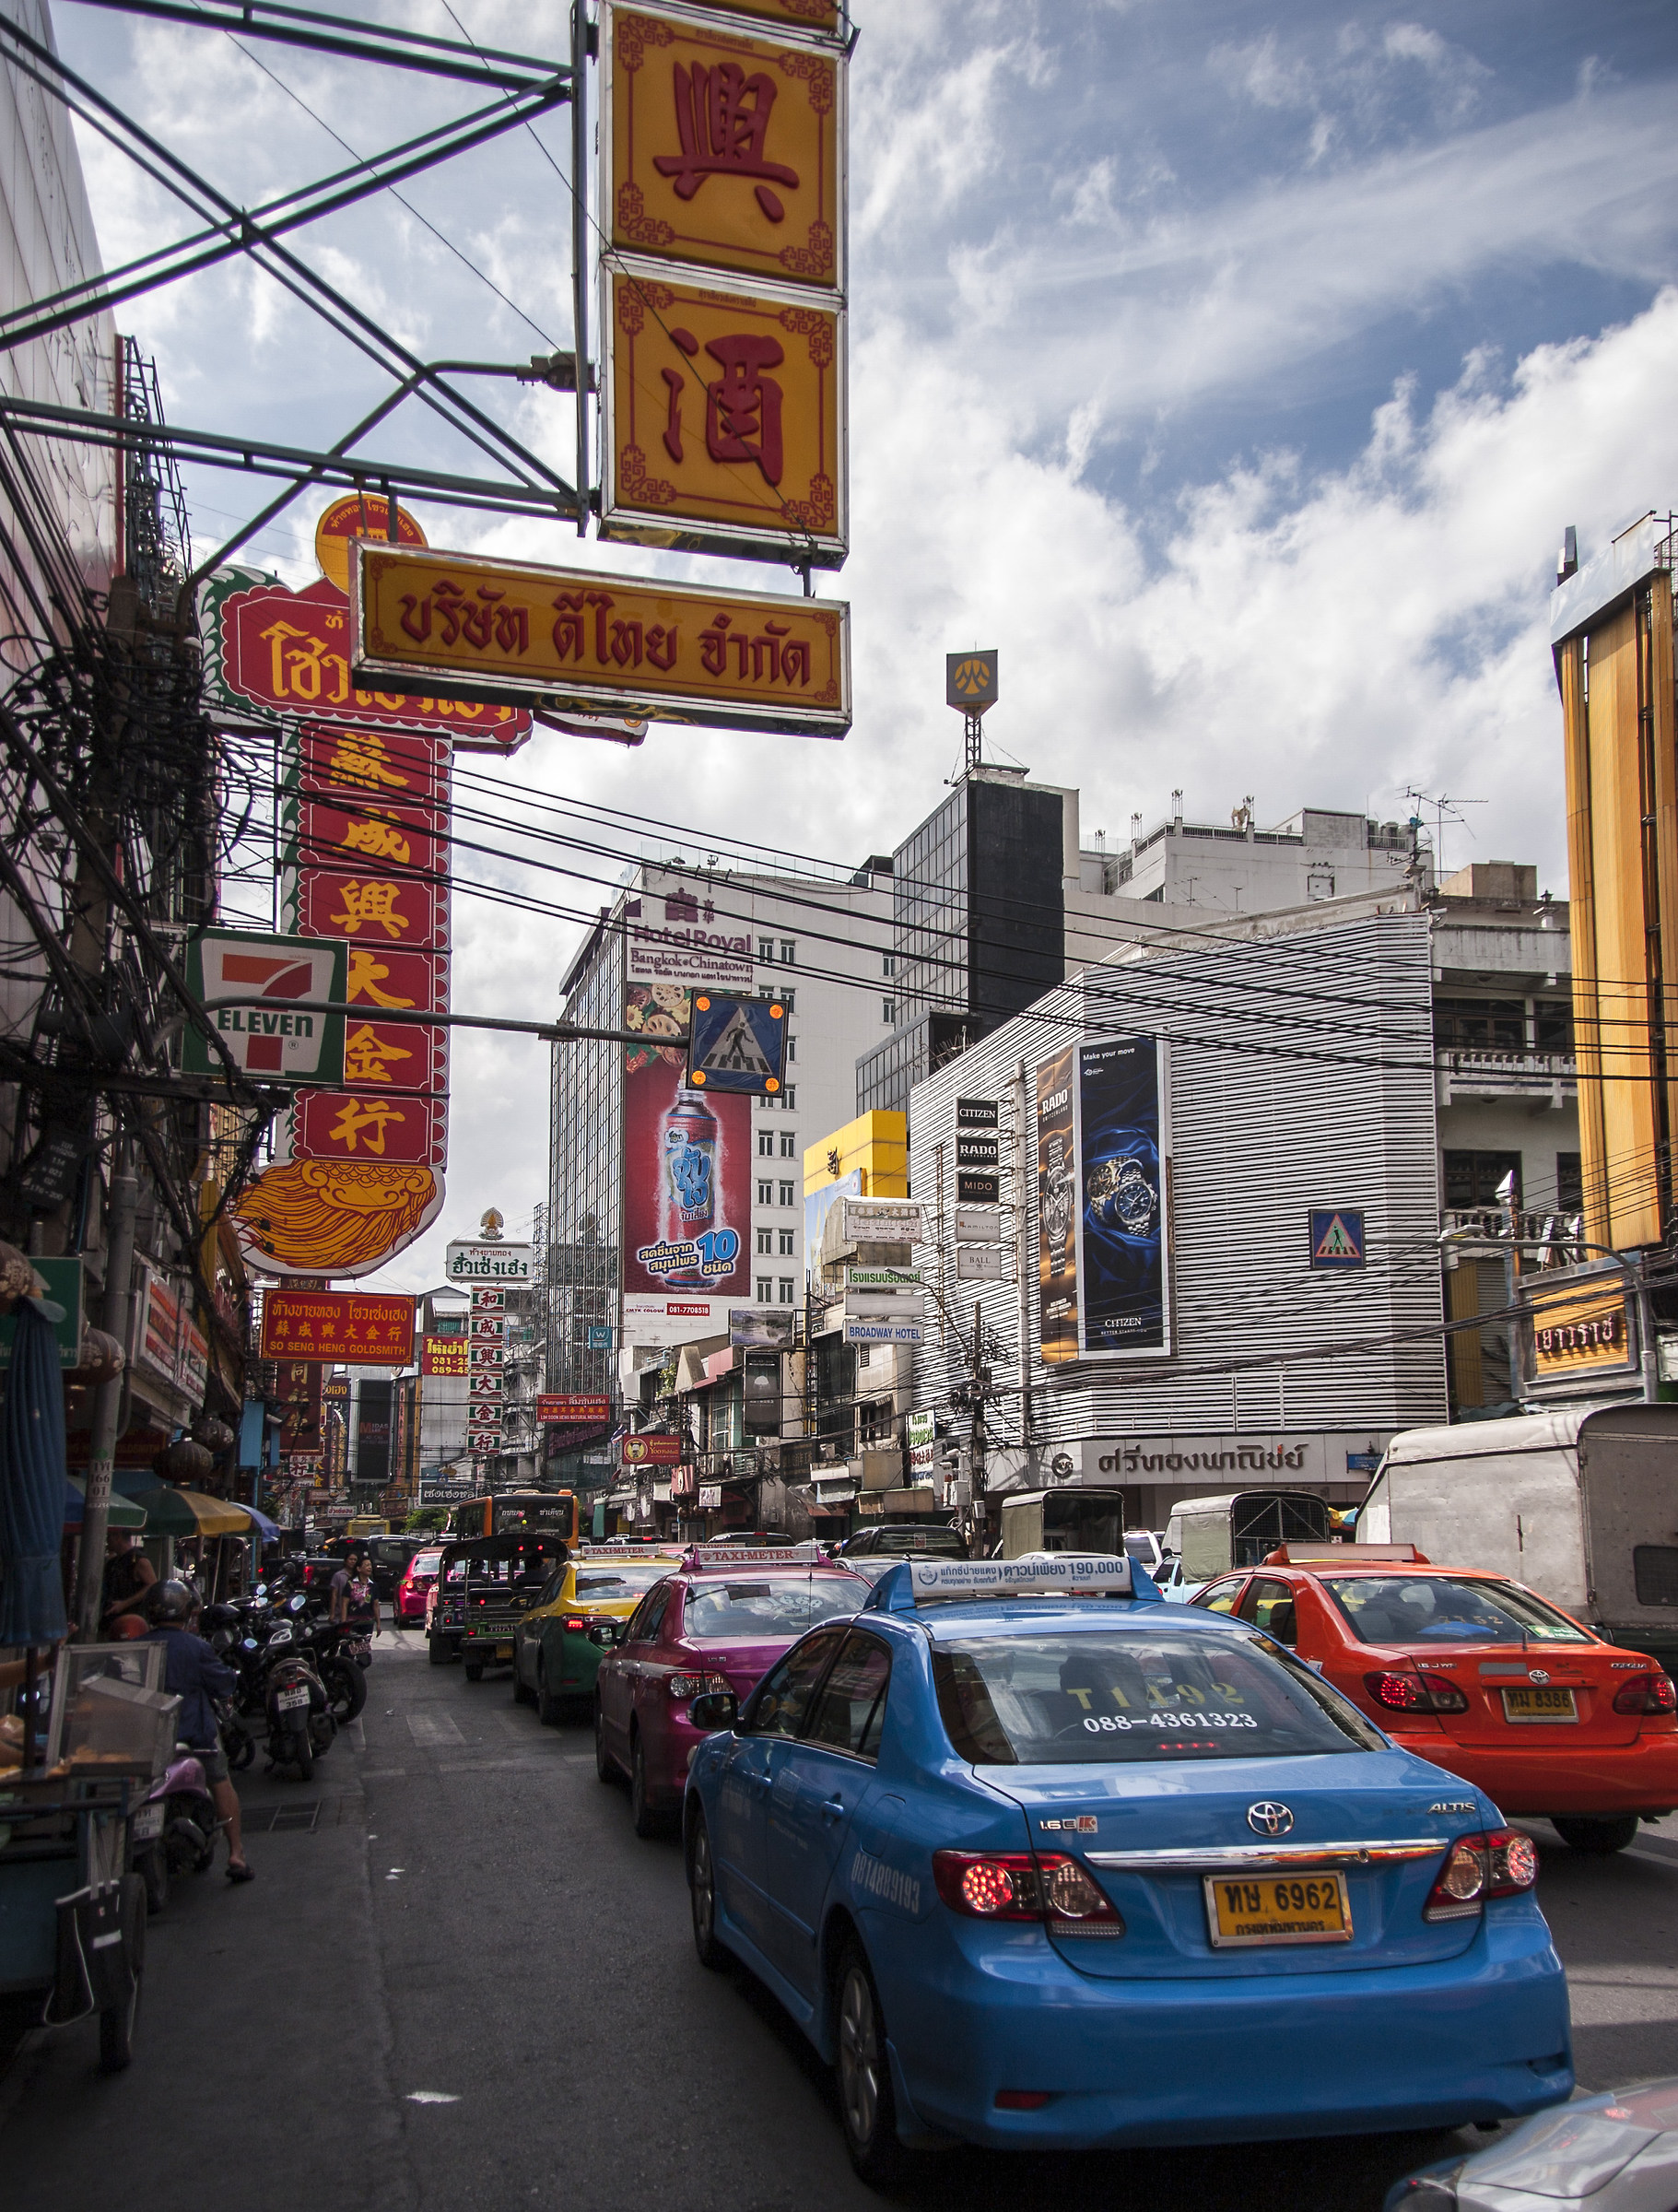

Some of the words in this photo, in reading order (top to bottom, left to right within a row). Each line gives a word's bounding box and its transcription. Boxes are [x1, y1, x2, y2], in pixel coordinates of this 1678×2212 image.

[399, 579, 529, 655] บริษัท
[698, 612, 811, 688] จำกัด
[634, 924, 691, 946] Hotel
[693, 929, 752, 953] Royal
[630, 950, 683, 968] Bangkok
[689, 956, 753, 972] Chinatown
[1083, 1053, 1101, 1062] Make
[1101, 1051, 1117, 1060] your
[1117, 1047, 1135, 1056] move
[1041, 1089, 1069, 1114] RADO
[958, 1108, 996, 1119] CITIZEN
[959, 1144, 997, 1155] RADO
[964, 1181, 992, 1191] MIDO
[640, 1240, 693, 1260] สดชื่นจาก
[698, 1230, 737, 1261] 10
[650, 1254, 698, 1274] สมุนไพร
[702, 1260, 733, 1275] ชนิด
[272, 1300, 341, 1319] ห้างขายทอง
[1105, 1317, 1142, 1327] CITIZEN
[849, 1326, 893, 1338] BROADWAY
[896, 1328, 921, 1339] HOTEL
[1535, 1312, 1614, 1352] เยาวราช
[269, 1341, 284, 1351] SO
[287, 1342, 315, 1352] SENG
[318, 1343, 346, 1353] HENG
[349, 1344, 406, 1356] GOLDSMITH
[1098, 1443, 1309, 1474] ศรีทองพาณิชย์
[711, 1549, 794, 1562] TAXI-METER
[1003, 1562, 1066, 1577] ดาวน์เพียง
[1068, 1561, 1123, 1576] 190,000
[1083, 1712, 1259, 1734] 088-4361323
[1426, 1802, 1476, 1814] ALTIS
[1224, 1884, 1261, 1913] ทษ
[1274, 1882, 1337, 1911] 6962
[1235, 1920, 1325, 1935] กรงเทพมหานคร
